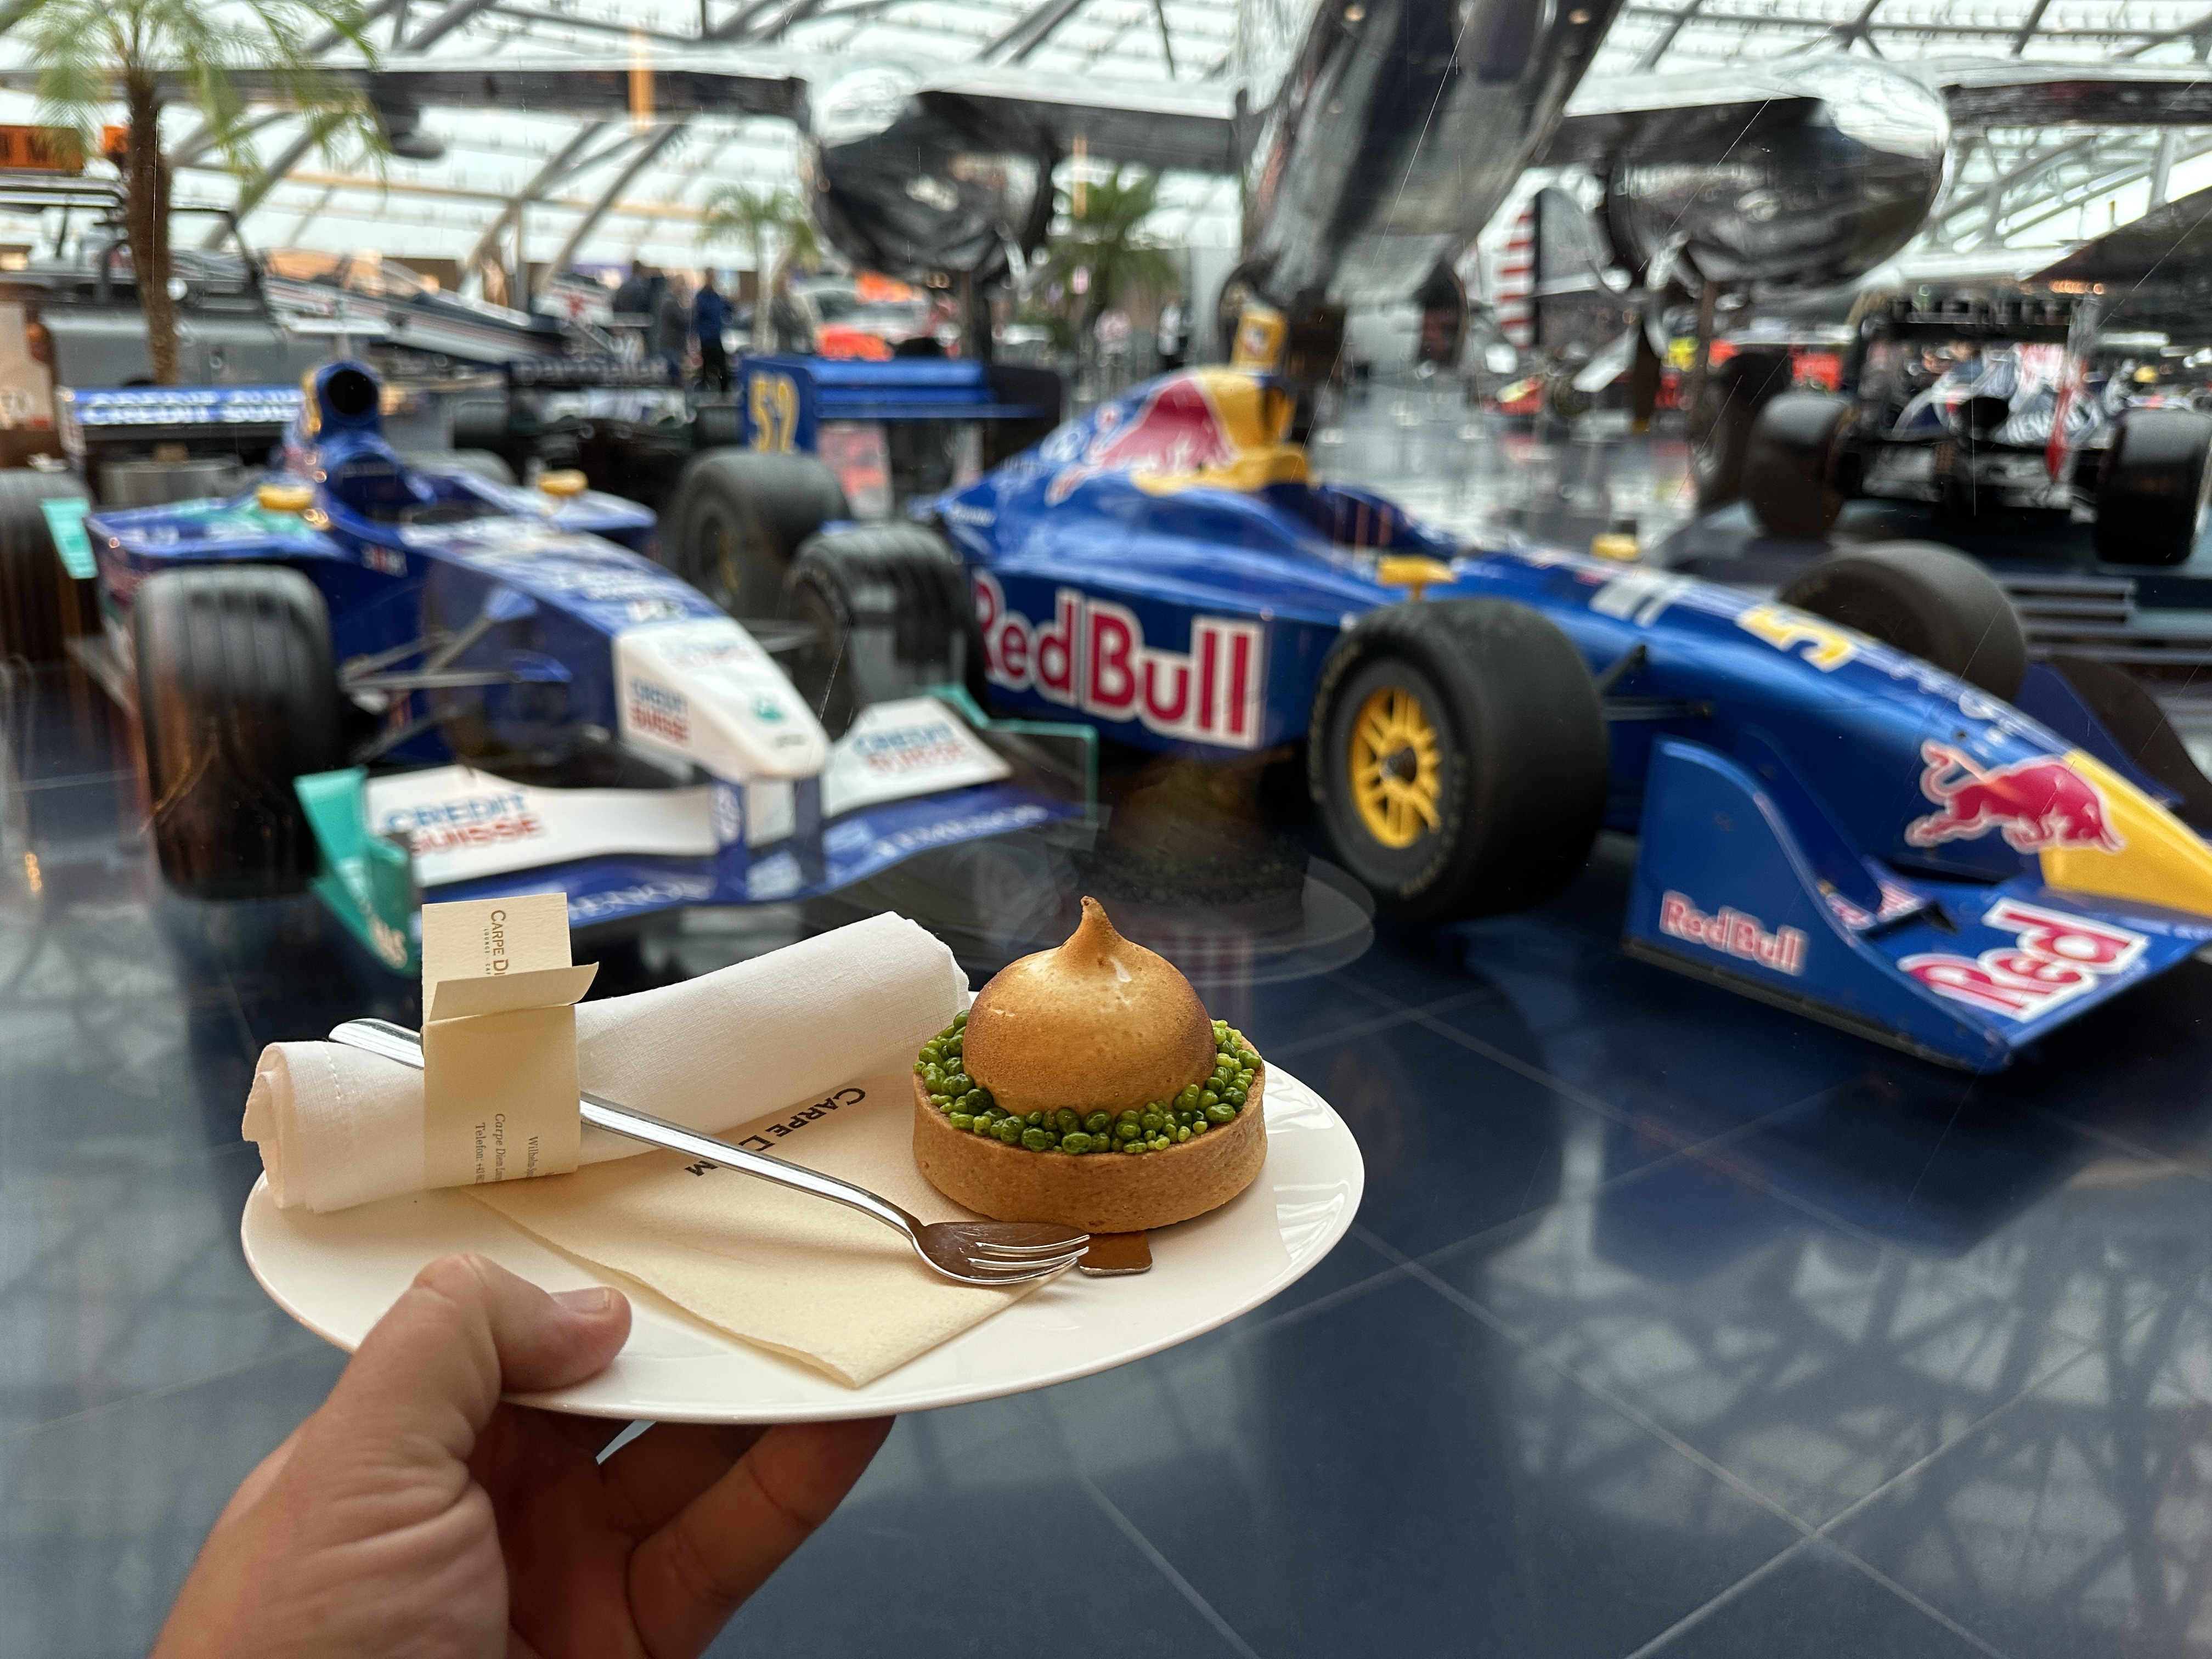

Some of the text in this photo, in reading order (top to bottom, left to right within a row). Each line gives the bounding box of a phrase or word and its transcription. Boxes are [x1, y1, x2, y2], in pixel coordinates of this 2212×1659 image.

[491, 910, 506, 955] CARPE
[475, 1122, 487, 1161] Telefon:
[493, 1113, 506, 1146] Carpe
[684, 1087, 866, 1176] CARPE DM
